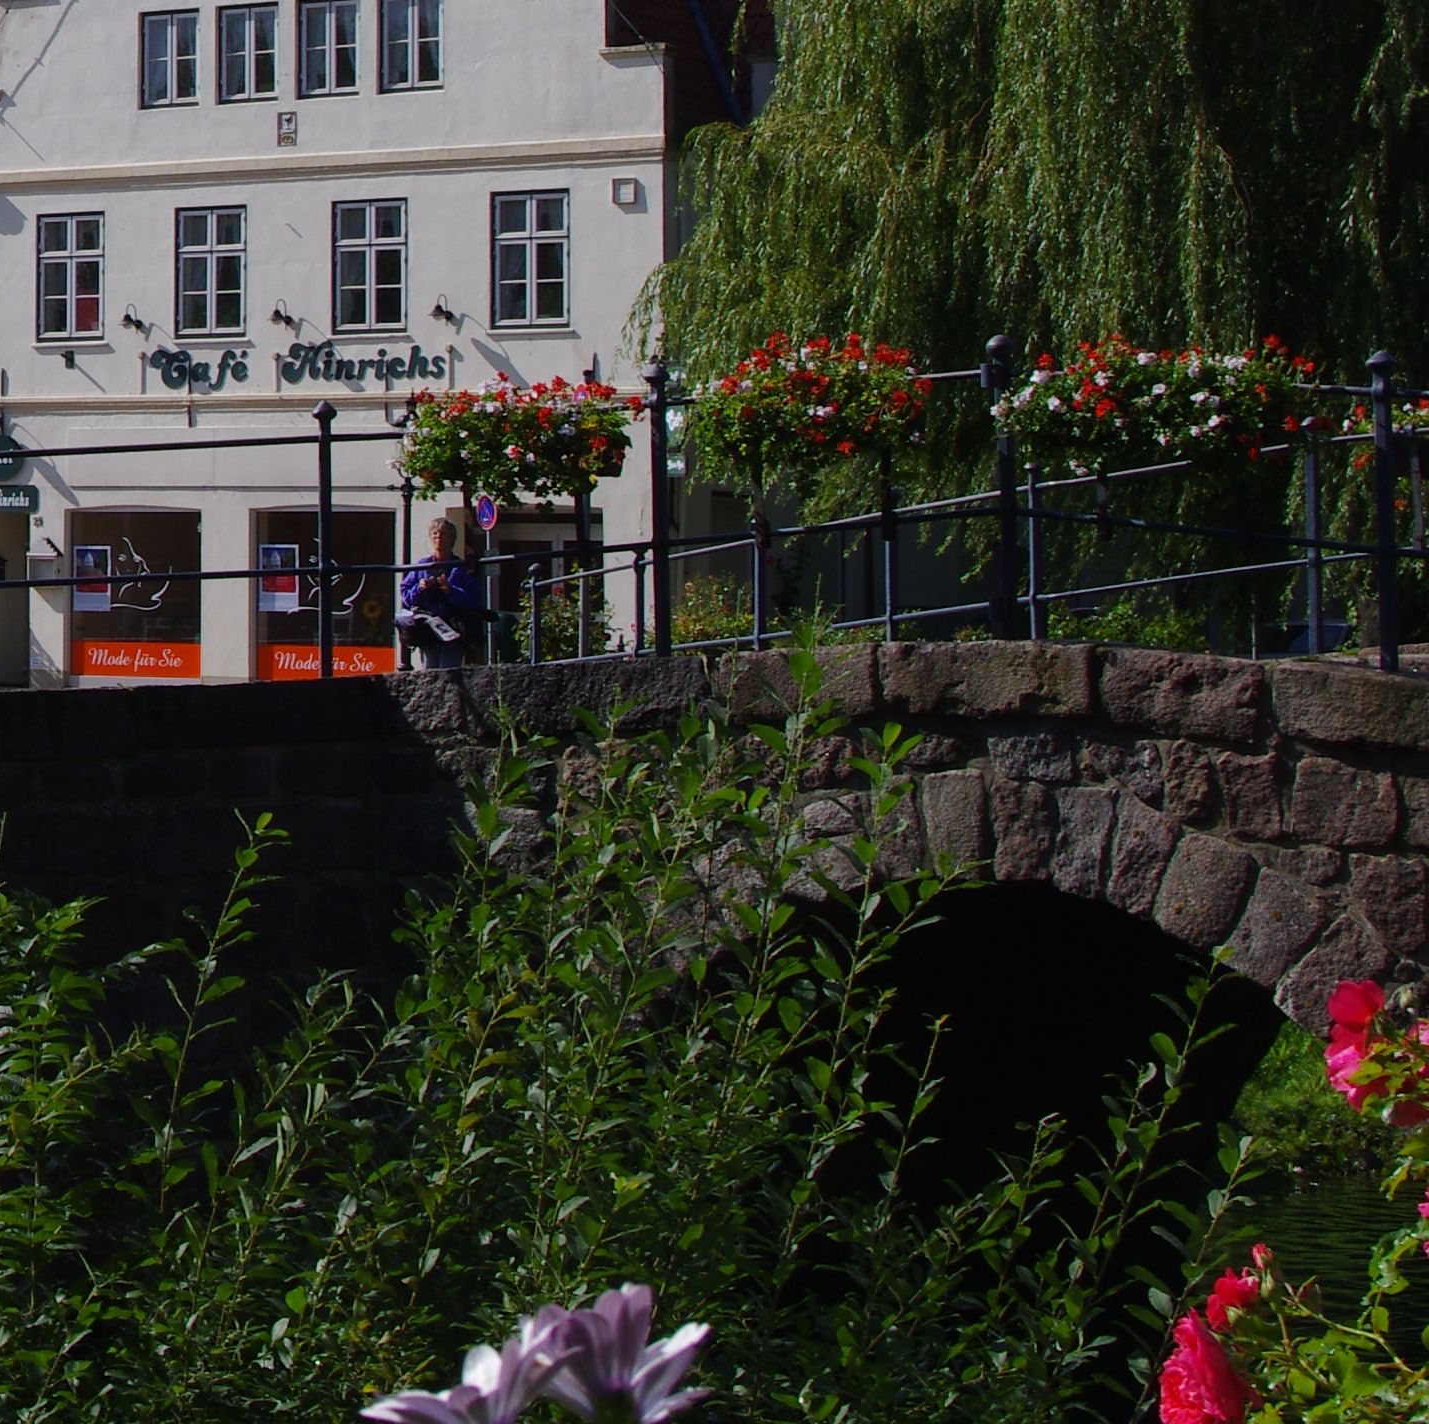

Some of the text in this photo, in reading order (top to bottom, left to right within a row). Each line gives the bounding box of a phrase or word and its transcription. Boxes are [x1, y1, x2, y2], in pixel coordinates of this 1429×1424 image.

[150, 339, 446, 390] Café Hinrichs
[88, 647, 183, 672] Mode für Sie
[274, 651, 319, 670] Mode
[348, 651, 375, 672] Sie
